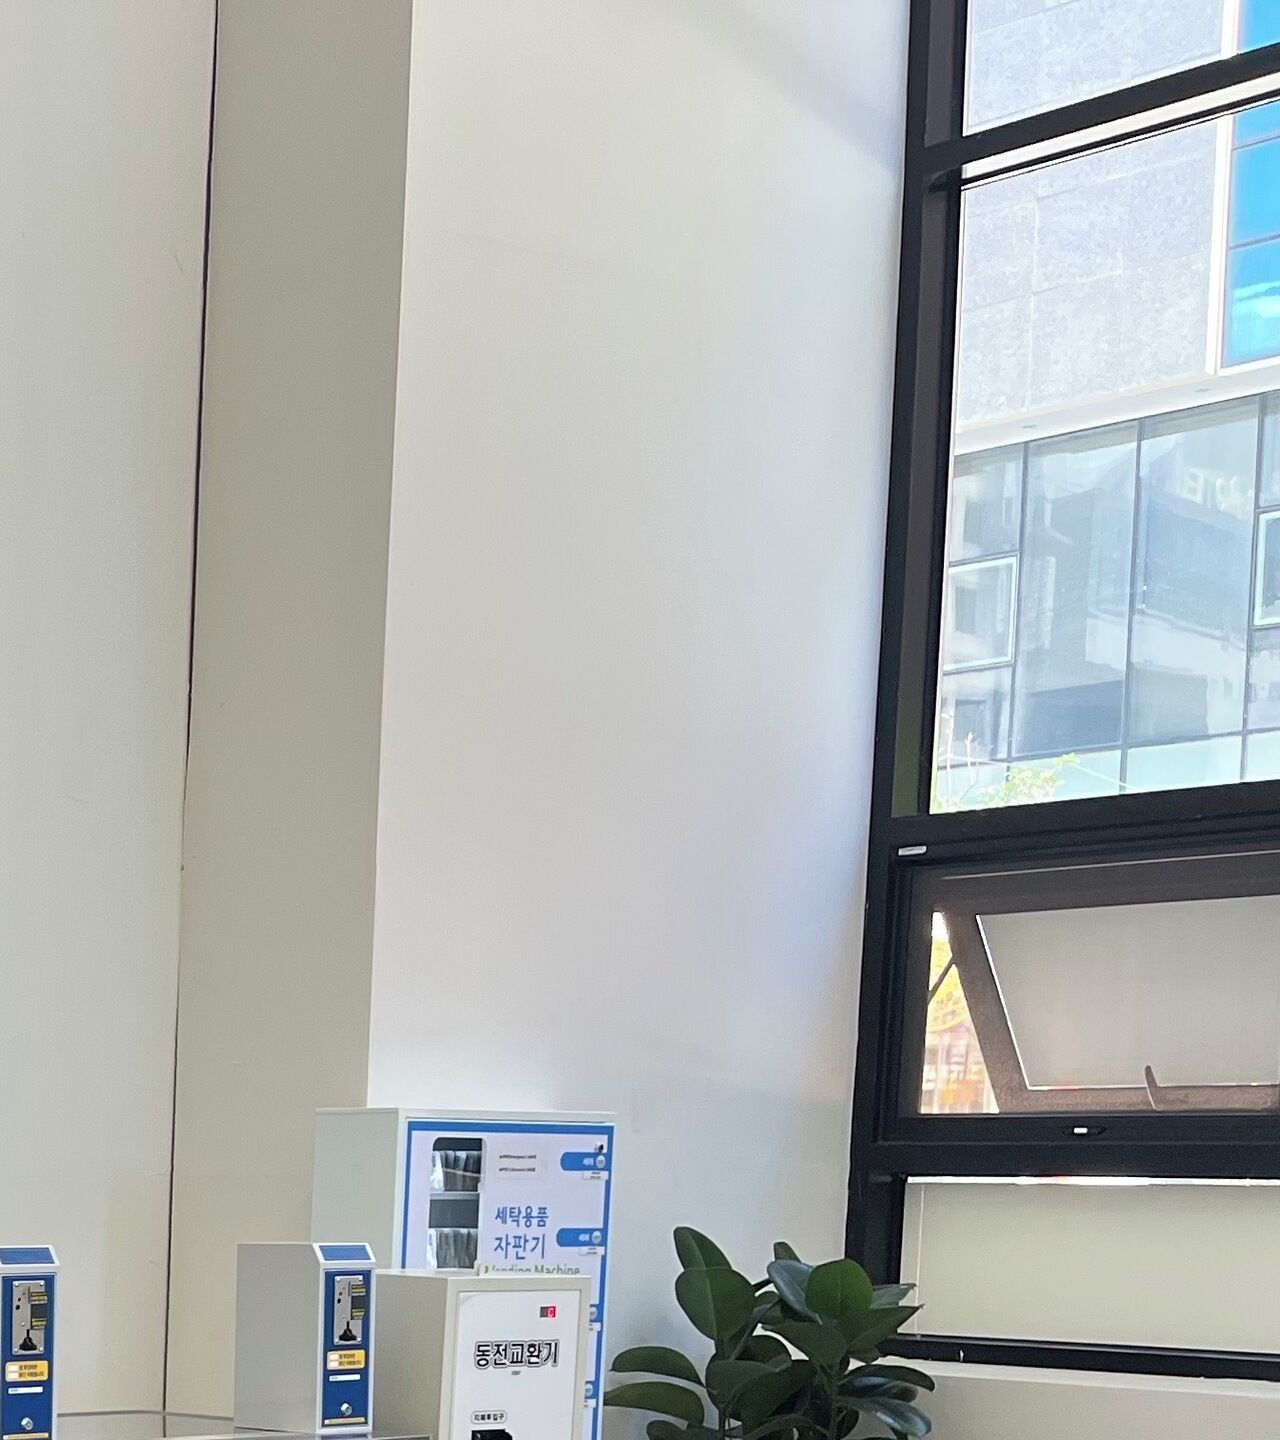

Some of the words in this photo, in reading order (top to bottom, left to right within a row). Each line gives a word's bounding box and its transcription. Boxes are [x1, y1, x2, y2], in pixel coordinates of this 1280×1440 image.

[494, 1205, 549, 1228] 세탁용품
[494, 1233, 545, 1260] 자판기
[476, 1341, 558, 1367] 동전교환기
